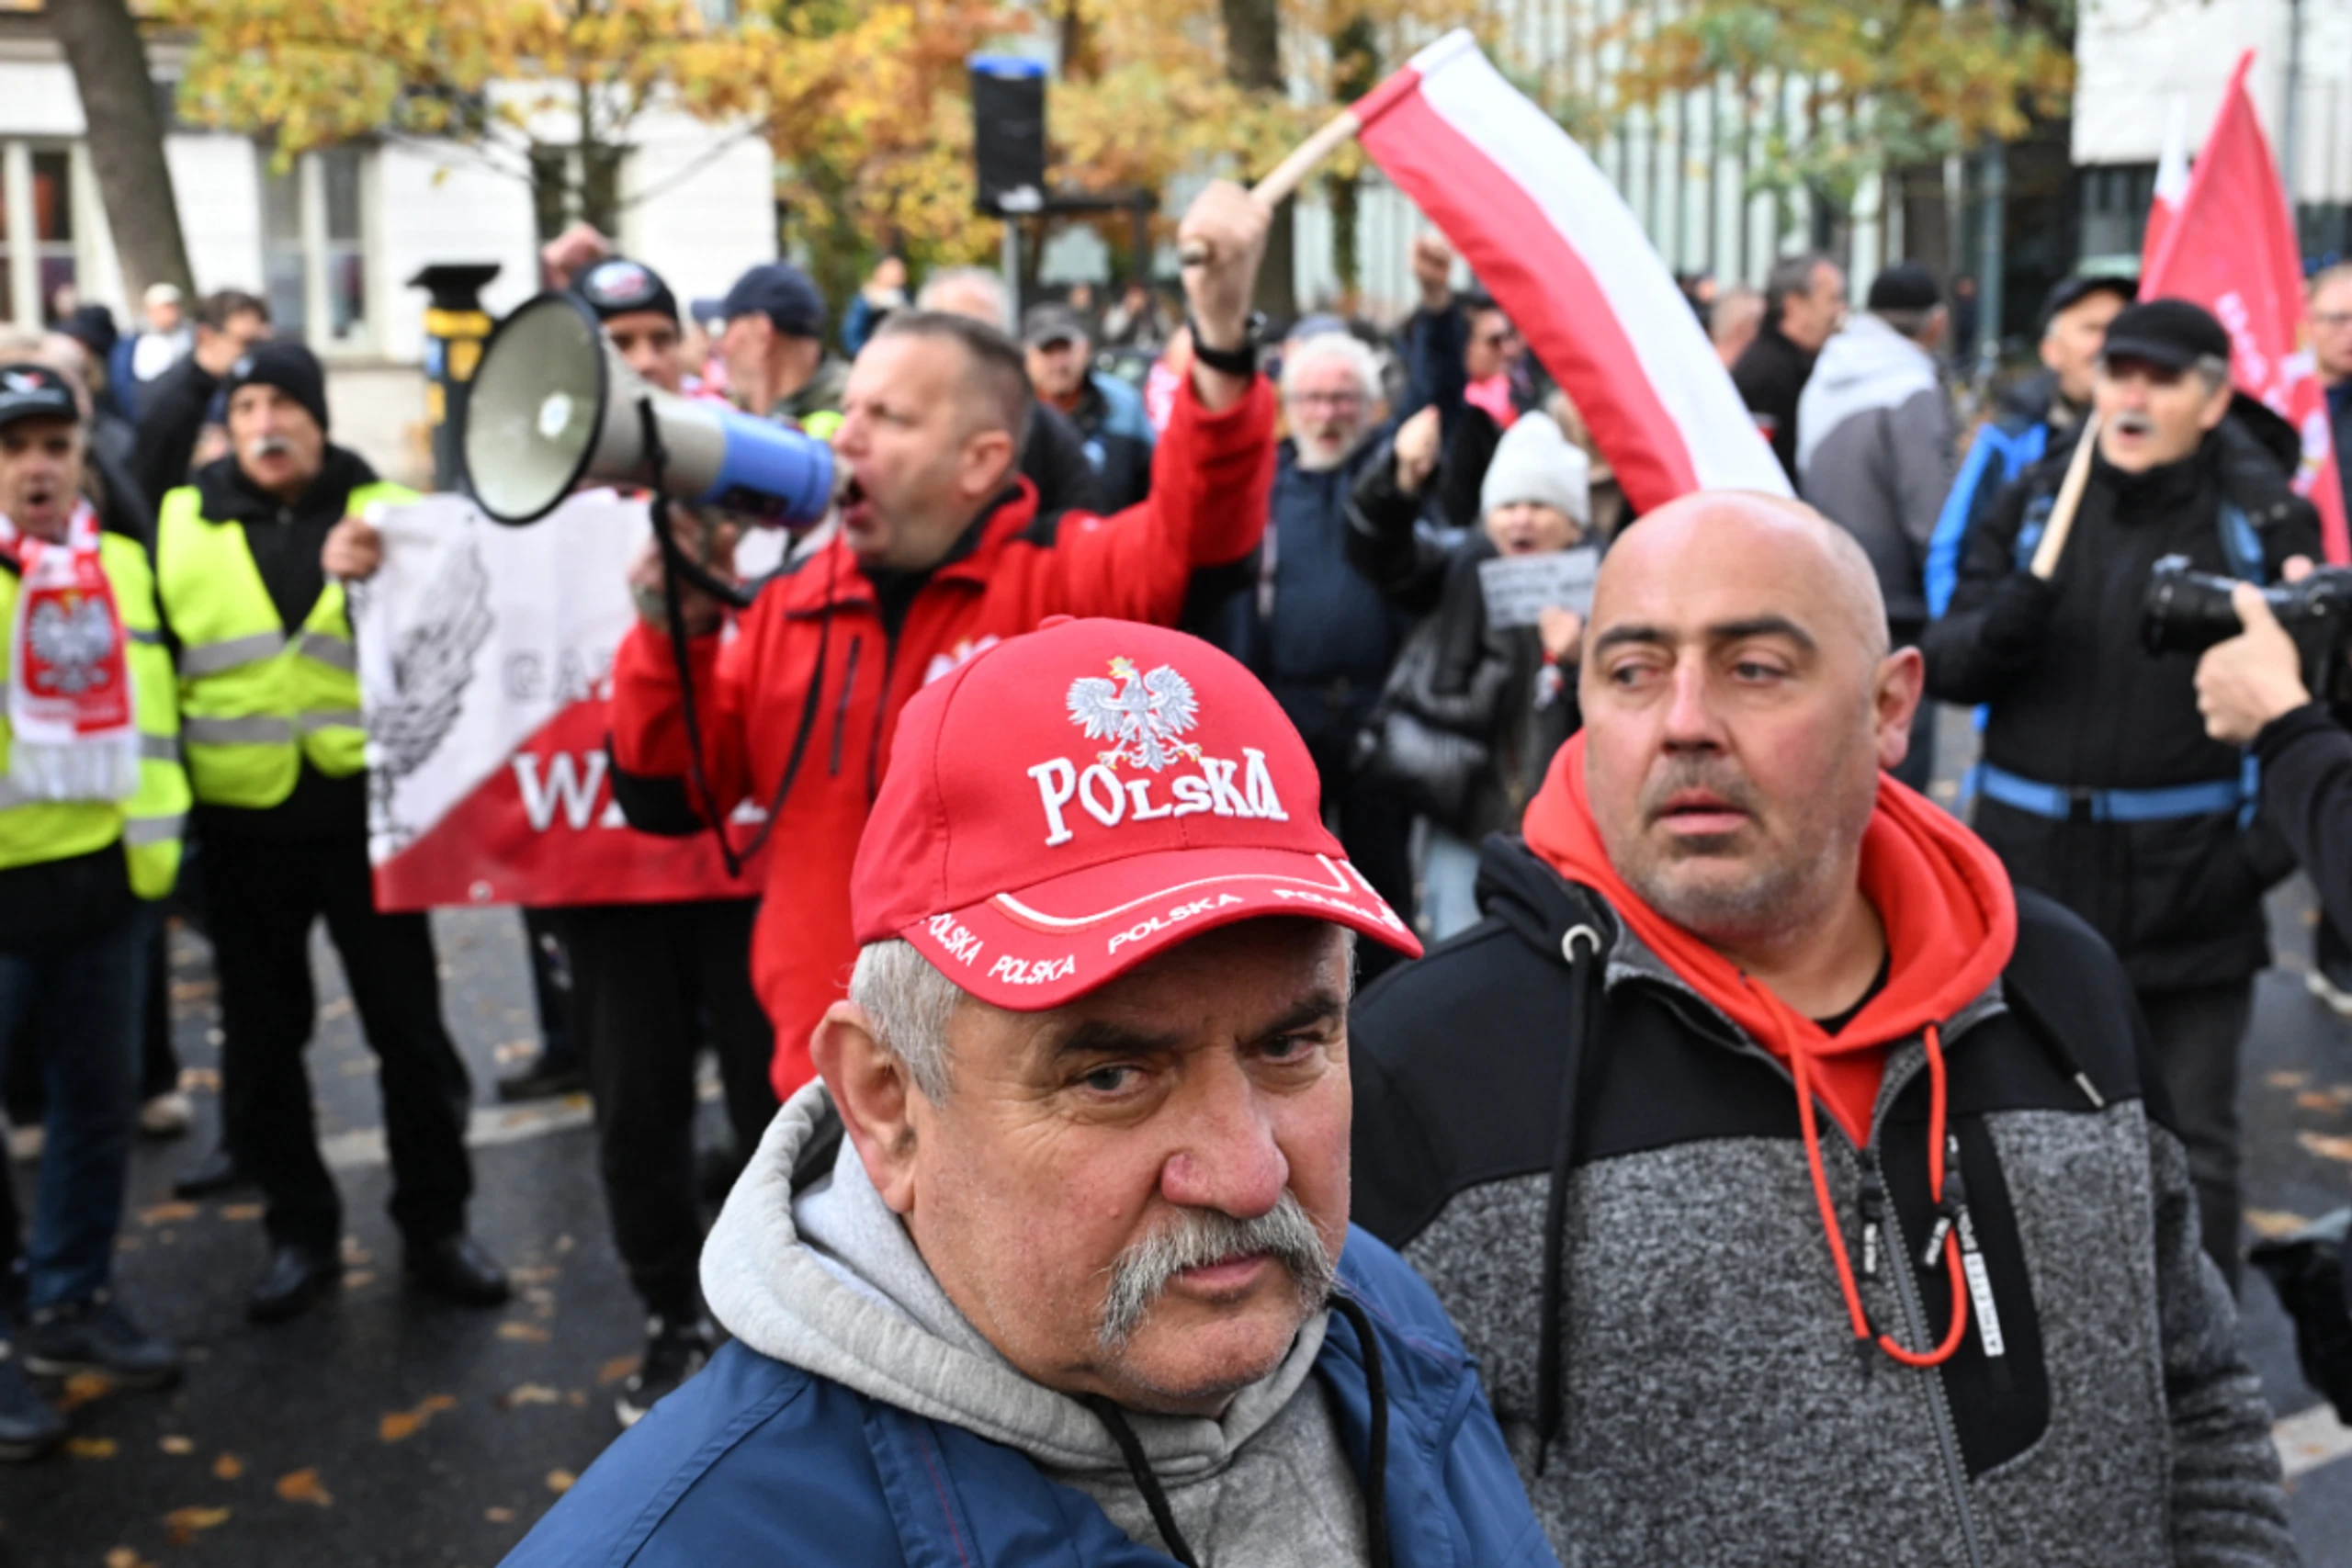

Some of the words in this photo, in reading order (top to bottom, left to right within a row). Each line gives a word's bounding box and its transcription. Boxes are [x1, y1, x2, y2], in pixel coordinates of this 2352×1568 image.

[1027, 747, 1289, 846] POLSKA
[920, 912, 984, 967] OLSKA
[1108, 893, 1244, 955] POLSKA
[987, 955, 1075, 985] POLSKA
